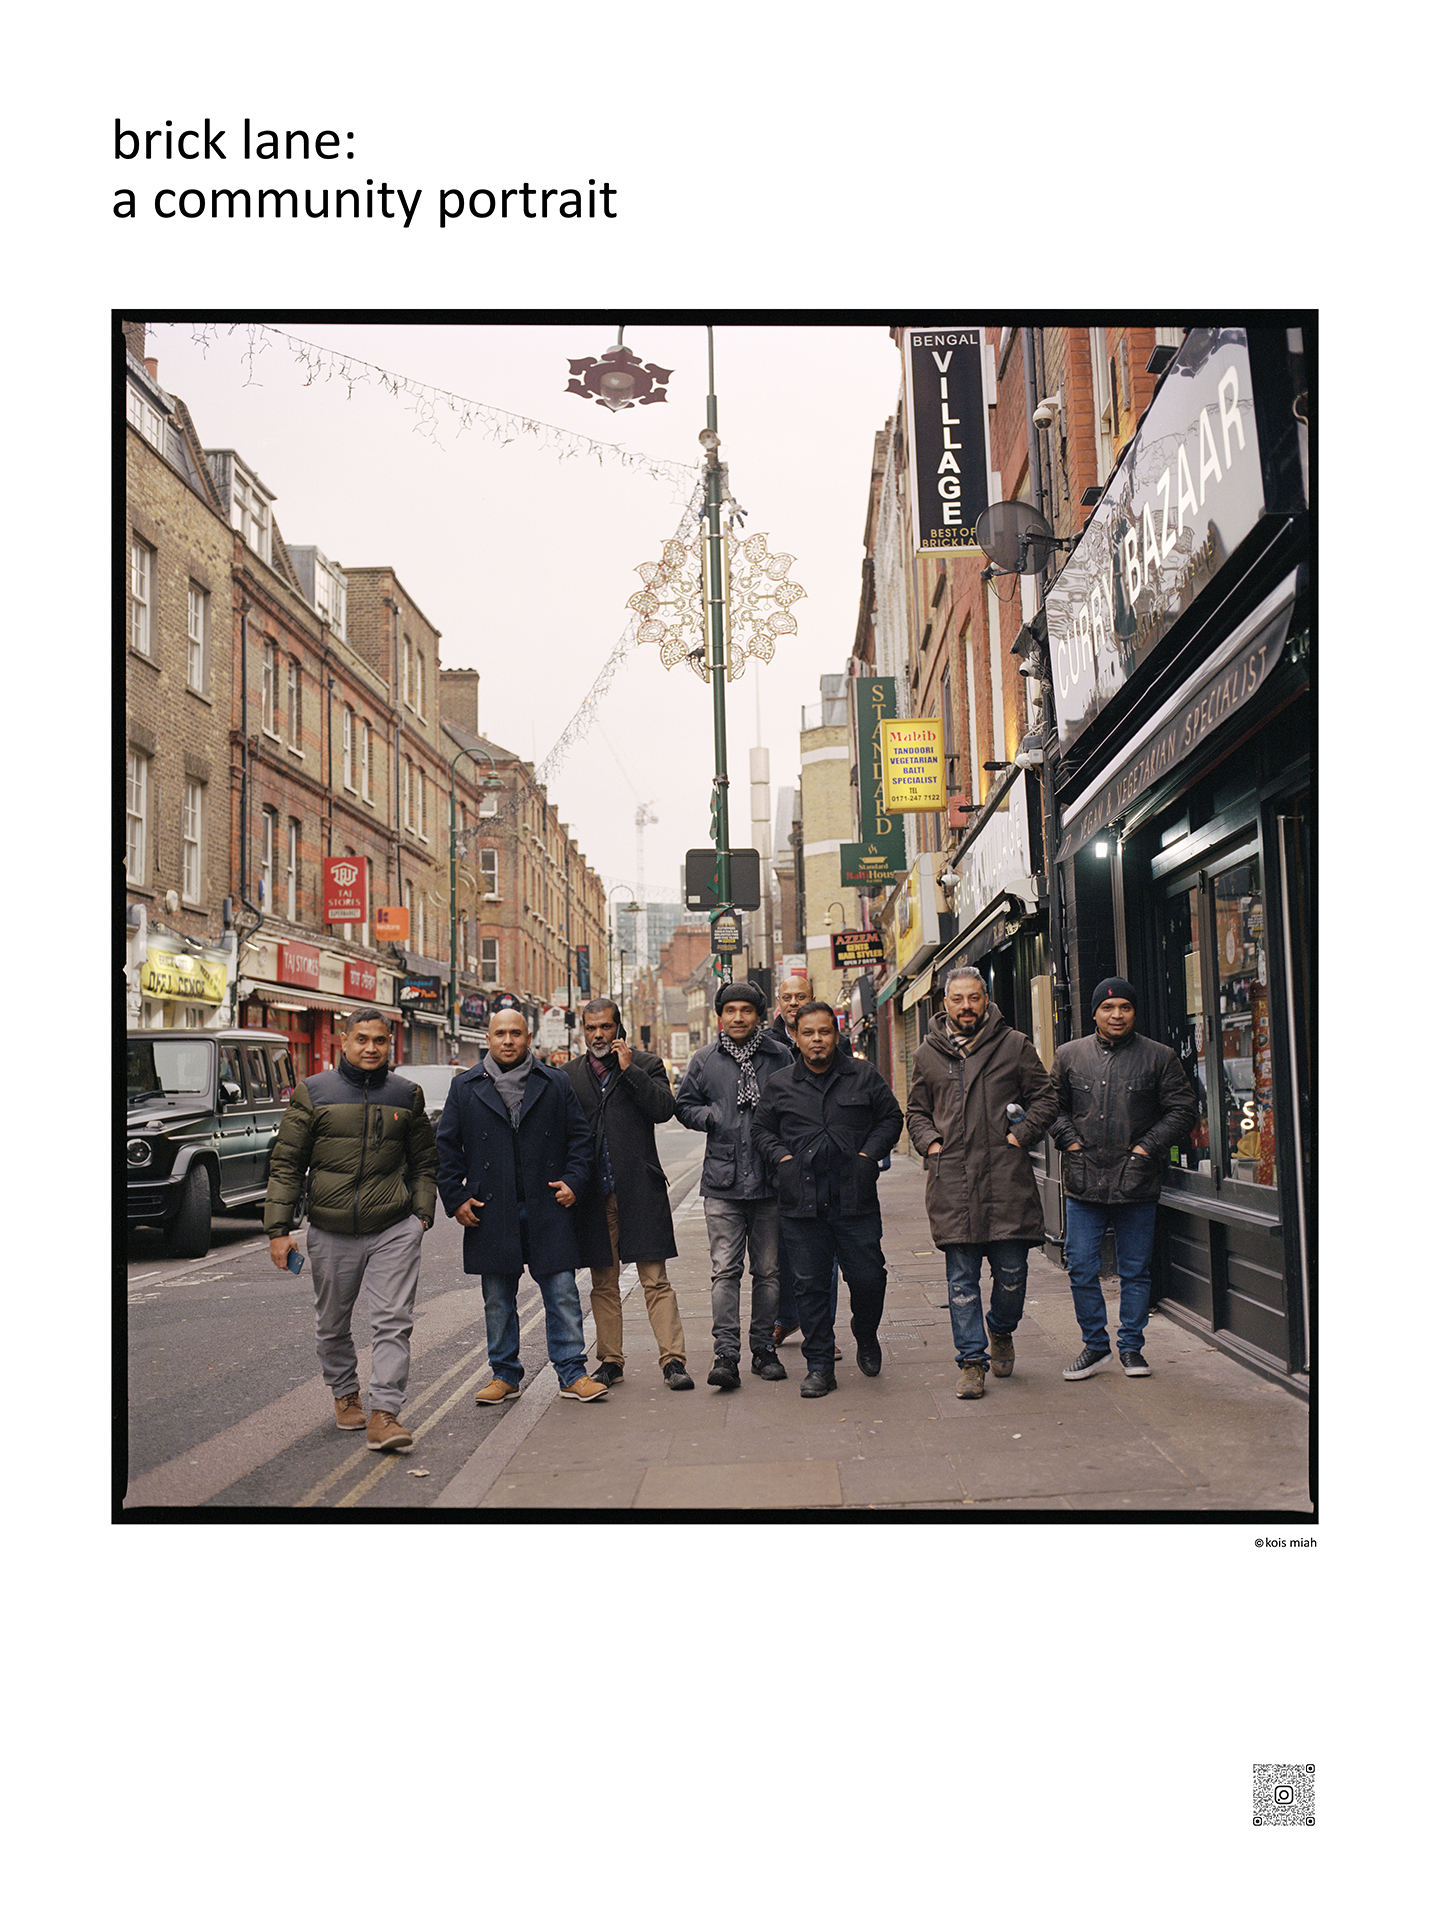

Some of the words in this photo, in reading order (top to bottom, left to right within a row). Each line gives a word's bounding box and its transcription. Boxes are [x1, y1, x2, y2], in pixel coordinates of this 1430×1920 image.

[913, 334, 978, 347] BENGAL
[931, 351, 963, 525] VILLAGE
[930, 528, 957, 538] BEST
[959, 527, 976, 537] OF
[1056, 558, 1115, 700] CURRY
[1124, 365, 1246, 606] BAZAAR
[922, 538, 959, 548] BRICK
[1116, 729, 1177, 808] VEGETARIAN
[1185, 645, 1267, 746] SPECIALIST
[893, 746, 934, 755] TANDOORI
[889, 756, 938, 765] VEGETARIAN
[903, 766, 925, 774] BALTI
[892, 776, 937, 785] SPECIALIST
[338, 889, 353, 898] TAJ
[328, 898, 361, 906] STORES
[835, 932, 880, 945] AZEEM
[846, 943, 869, 952] GENTS
[856, 949, 883, 959] STYLES
[284, 952, 296, 974] TAJ
